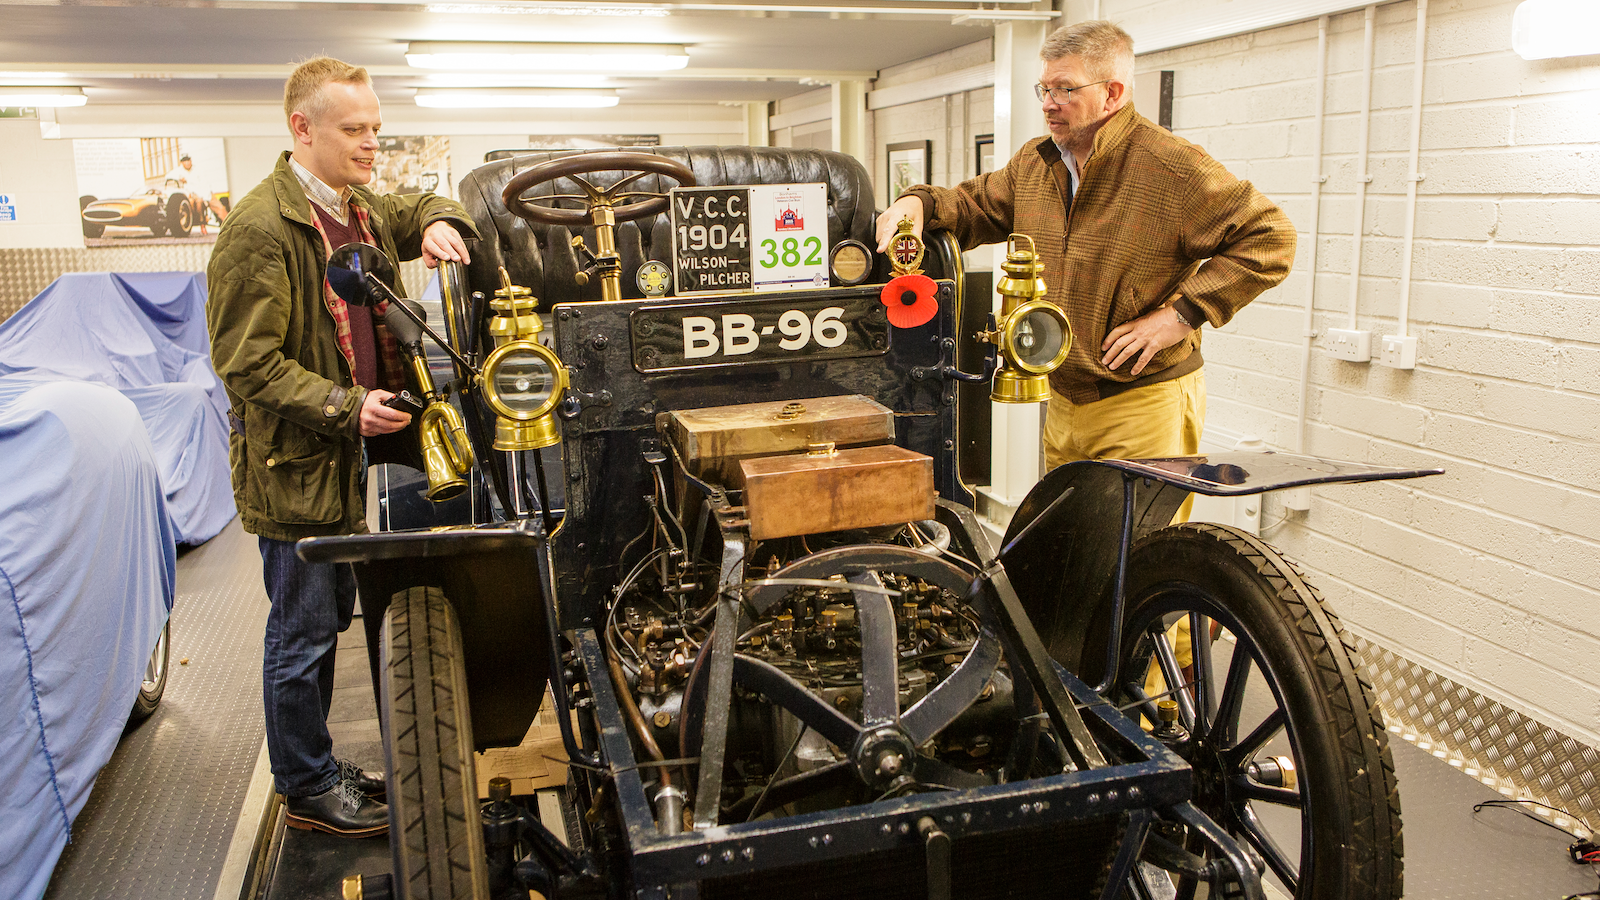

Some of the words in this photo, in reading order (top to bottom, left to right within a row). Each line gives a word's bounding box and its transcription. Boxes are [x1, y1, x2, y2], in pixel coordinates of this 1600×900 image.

[422, 175, 438, 190] BP
[677, 195, 747, 219] V.C.C.
[678, 223, 747, 251] 1904
[759, 236, 823, 269] 382
[699, 272, 750, 286] PILCHER
[682, 306, 848, 359] BB-96
